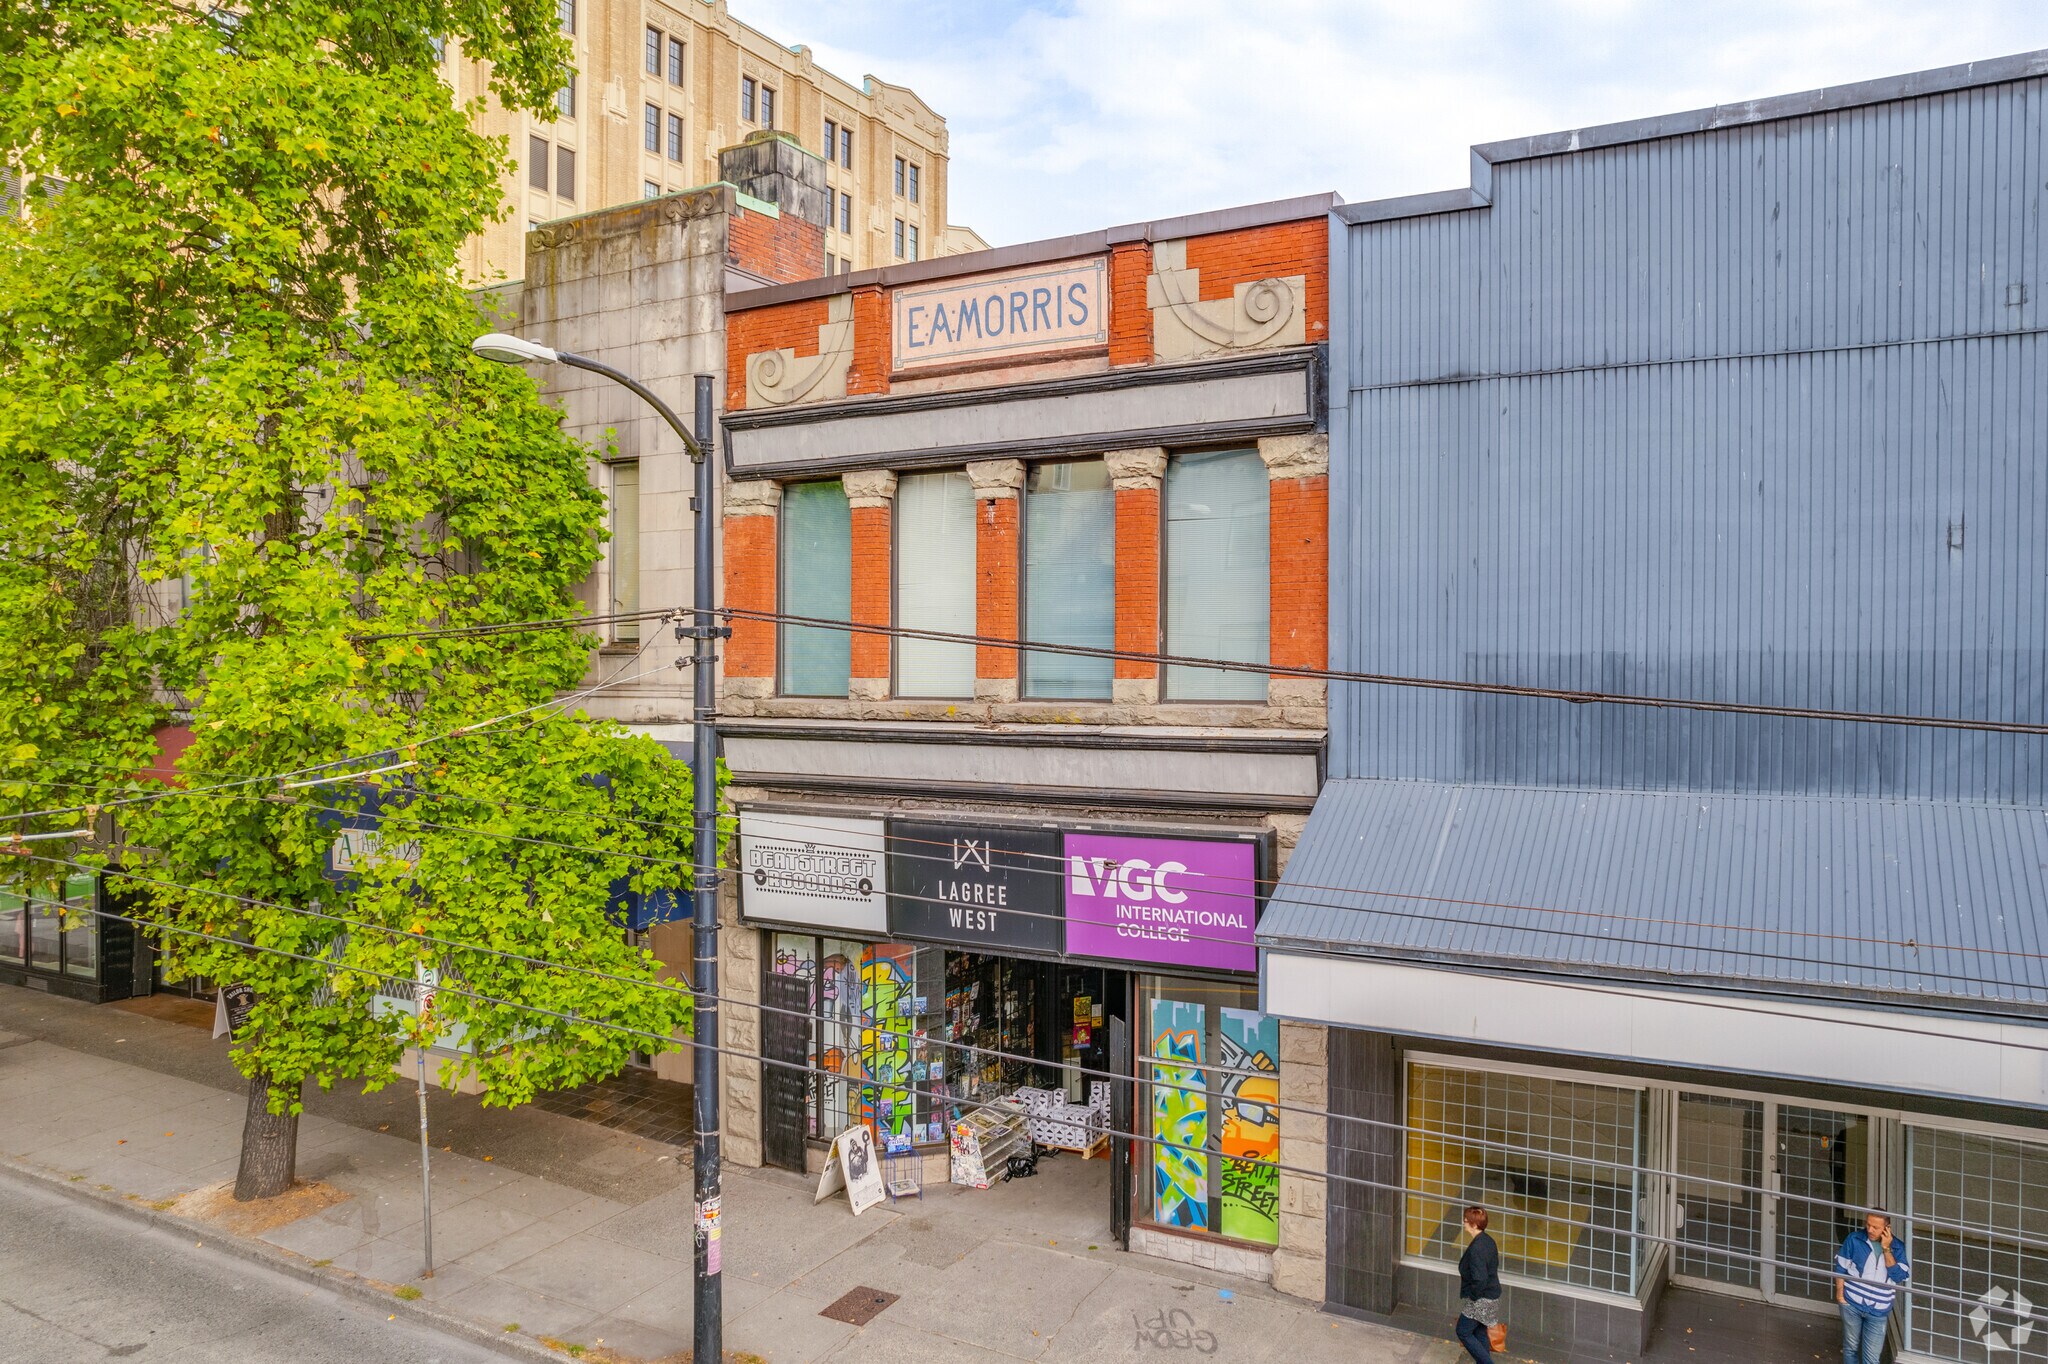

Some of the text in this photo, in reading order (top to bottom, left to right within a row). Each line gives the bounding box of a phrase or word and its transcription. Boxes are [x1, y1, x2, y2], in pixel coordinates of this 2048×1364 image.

[749, 849, 877, 878] BEATSTREET
[767, 869, 858, 896] RECORDS
[938, 879, 1007, 906] LAGREE
[949, 907, 997, 932] WEST
[1116, 904, 1248, 929] INTERNATIONAL
[1116, 922, 1191, 943] COLLEGE
